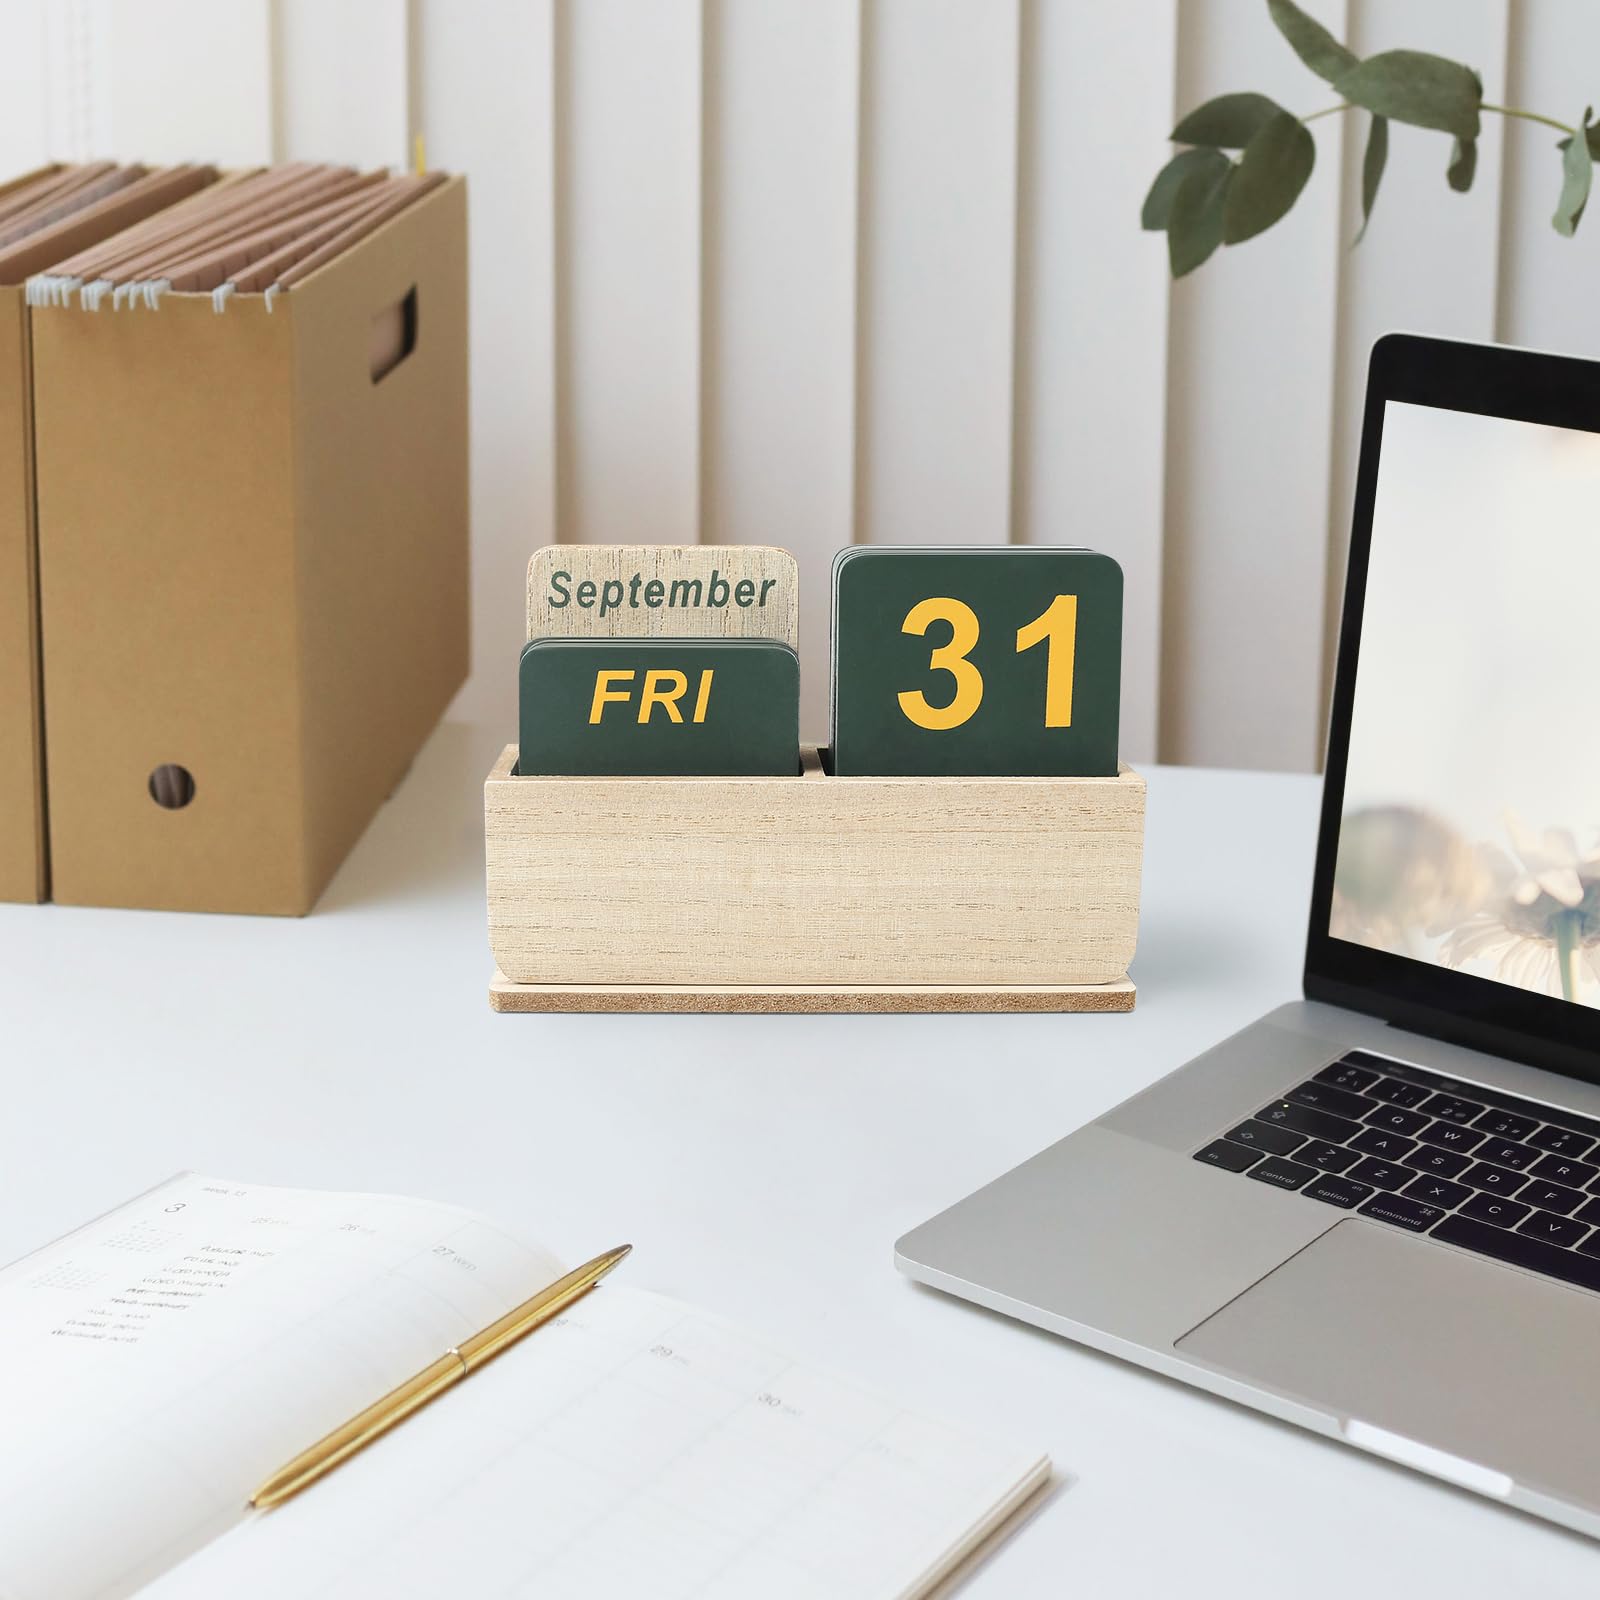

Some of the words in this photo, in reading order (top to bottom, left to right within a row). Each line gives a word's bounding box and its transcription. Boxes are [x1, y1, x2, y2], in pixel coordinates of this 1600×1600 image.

[548, 570, 777, 617] September
[897, 594, 1078, 731] 31
[588, 670, 714, 724] FRI
[1391, 1115, 1404, 1124] Q
[1496, 1123, 1508, 1131] 3
[1444, 1131, 1461, 1140] W
[1376, 1140, 1388, 1149] A
[1207, 1152, 1219, 1160] fn
[1501, 1149, 1514, 1158] E
[1431, 1157, 1445, 1165] S
[1373, 1169, 1389, 1178] Z
[1556, 1166, 1570, 1175] R
[1260, 1169, 1296, 1185] control
[1486, 1174, 1500, 1183] D
[1317, 1188, 1350, 1203] option
[1429, 1187, 1445, 1196] X
[1544, 1192, 1558, 1200] F
[164, 1202, 187, 1213] 3
[1488, 1206, 1502, 1214] C
[1371, 1206, 1422, 1226] command
[1549, 1223, 1562, 1232] V
[432, 1246, 456, 1256] 27
[650, 1344, 673, 1357] 29
[757, 1393, 782, 1407] 30
